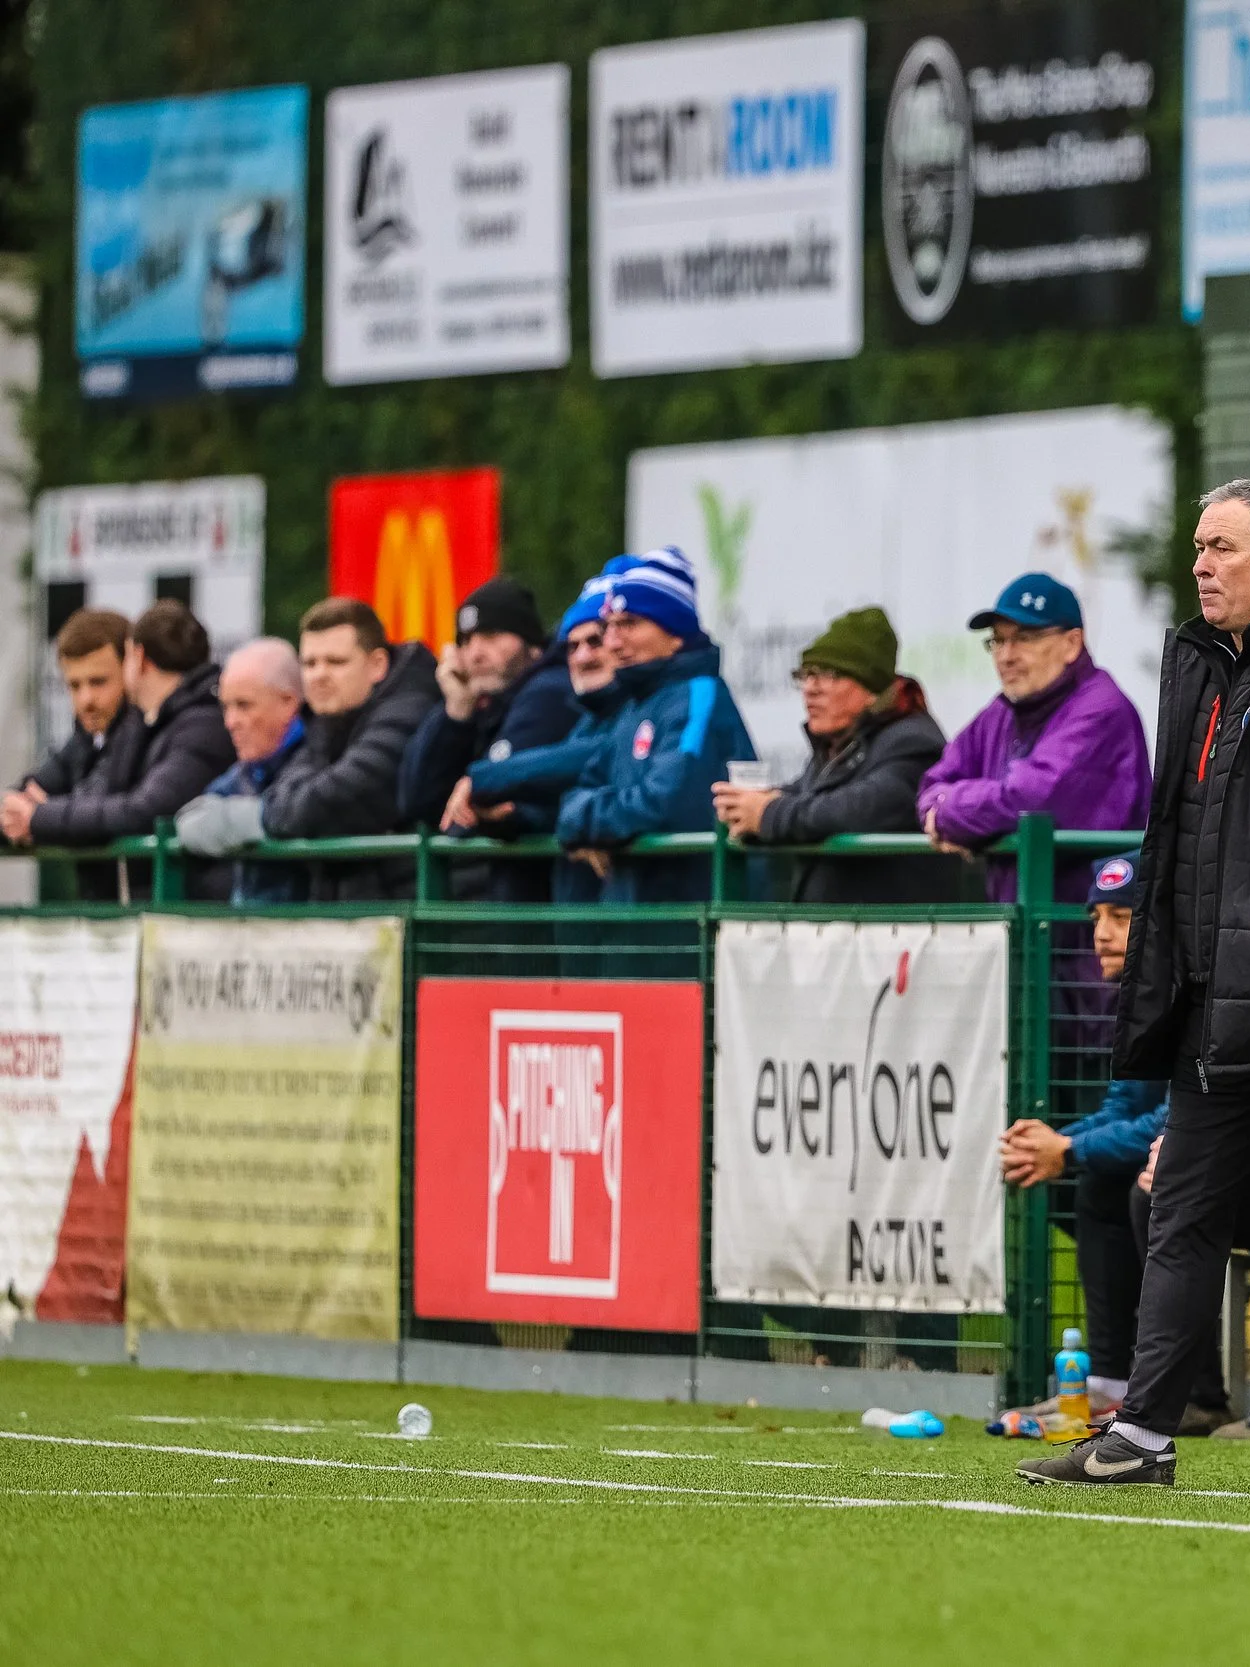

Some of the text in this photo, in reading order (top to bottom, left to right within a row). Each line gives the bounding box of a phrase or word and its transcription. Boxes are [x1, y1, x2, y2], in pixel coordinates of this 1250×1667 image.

[508, 1043, 604, 1154] PITCHING
[752, 976, 956, 1192] everyone
[847, 1219, 950, 1285] ACTIVE
